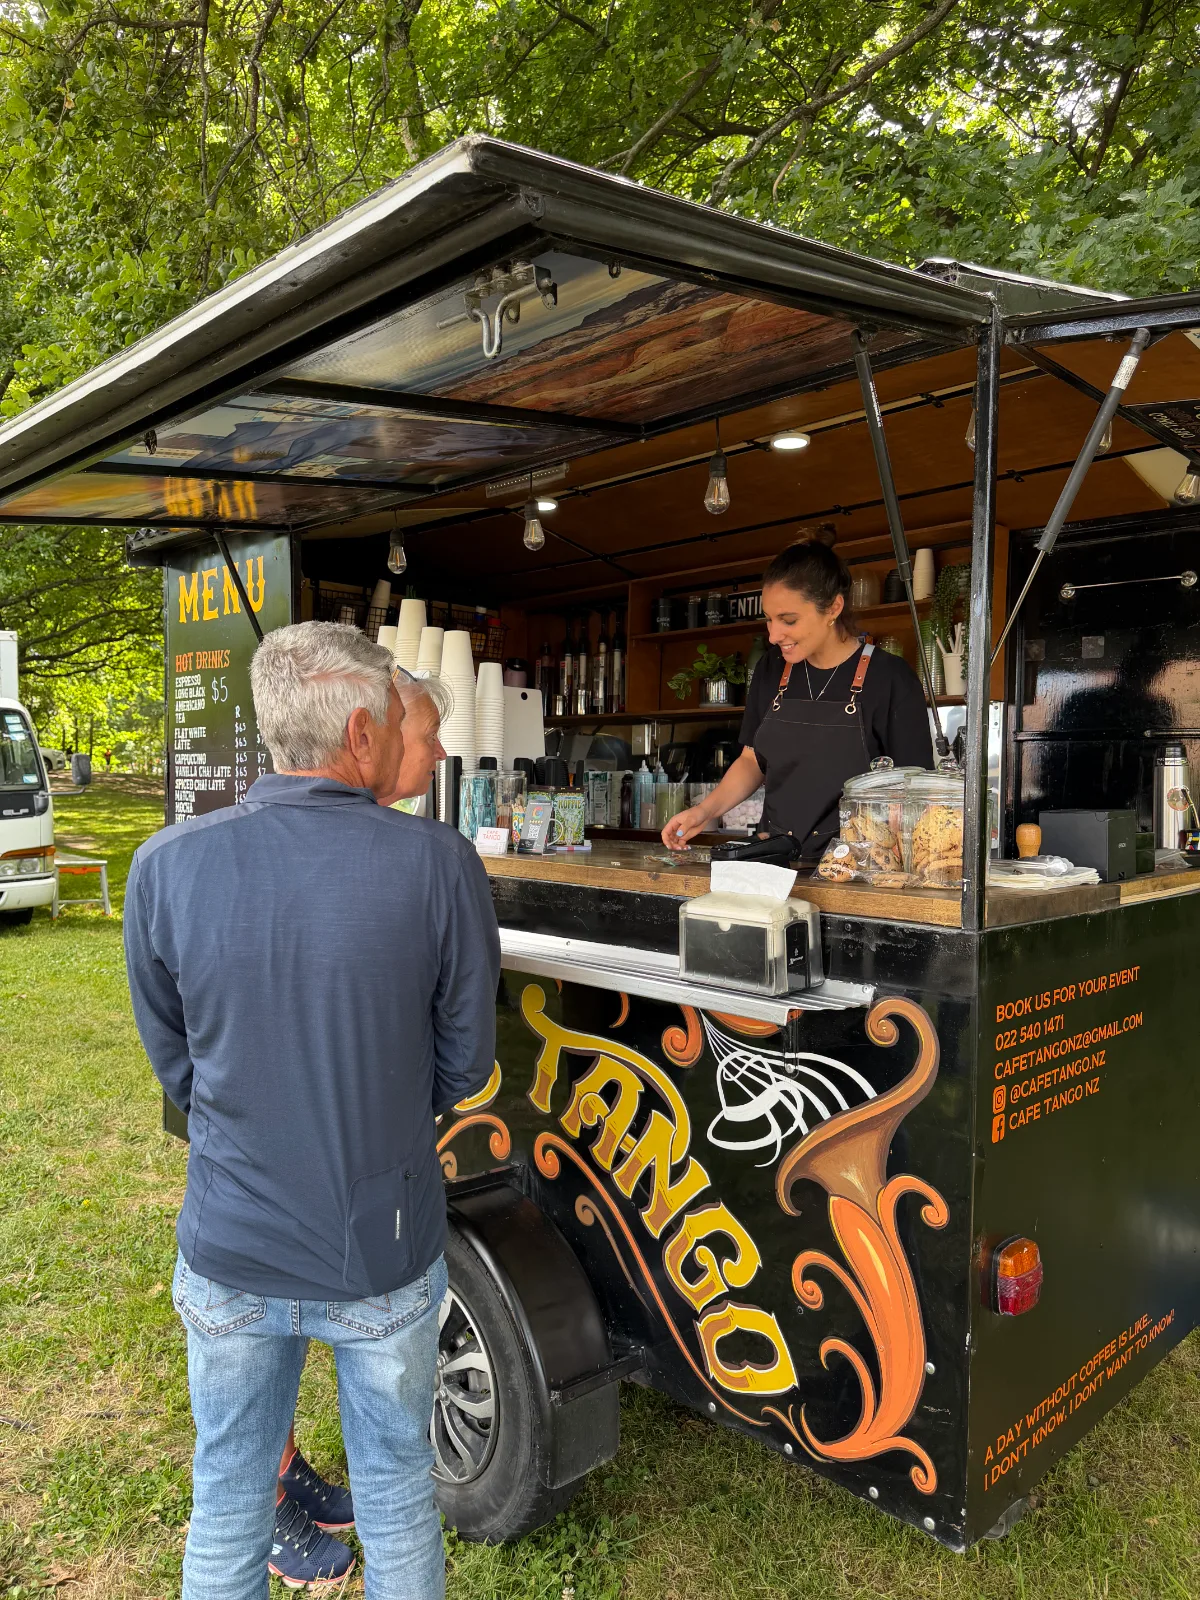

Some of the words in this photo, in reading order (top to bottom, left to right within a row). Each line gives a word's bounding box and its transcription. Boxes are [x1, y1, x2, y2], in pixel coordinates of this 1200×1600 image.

[178, 555, 266, 624] MENU
[175, 651, 194, 673] HOT
[195, 649, 231, 670] DRINKS
[174, 688, 189, 700] LONG
[188, 686, 206, 699] BLACK
[175, 673, 202, 688] ESPRESSO
[211, 676, 229, 705] $5
[175, 698, 206, 712] AMERICANO
[235, 704, 241, 719] R
[175, 711, 186, 724] TEA
[174, 727, 188, 740] FLAT
[188, 726, 207, 739] WHITE
[174, 739, 191, 751] LATTE
[174, 752, 207, 766] CAPPUCCINO
[174, 765, 198, 778] VANILLA
[198, 765, 212, 778] CHAI
[213, 766, 232, 778] LATTE
[174, 778, 194, 791] SPICED
[194, 778, 208, 792] CHAI
[208, 778, 226, 791] LATTE
[174, 789, 196, 803] MATCHA
[174, 801, 194, 814] MOCHA
[996, 996, 1033, 1023] BOOK
[1034, 991, 1051, 1011] US
[1052, 984, 1076, 1006] FOR
[1078, 975, 1107, 998] YOUR
[1108, 965, 1141, 989] EVENT
[995, 1029, 1017, 1051] 022
[1019, 1021, 1041, 1043] 540
[1043, 1013, 1065, 1036] 1471
[994, 1011, 1143, 1080] CAFETANGONZ@GMAIL.COM
[1010, 1050, 1106, 1104] @CAFETANGO.NZ
[1008, 1102, 1041, 1130] CAFE
[1043, 1084, 1083, 1115] TANGO
[1085, 1076, 1101, 1097] NZ
[521, 982, 800, 1398] TANGO
[984, 1445, 994, 1466] A
[996, 1419, 1023, 1455] DAY
[1025, 1372, 1078, 1429] WITHOUT
[1079, 1341, 1117, 1383] COFFEE
[1118, 1331, 1128, 1350] IS
[984, 1473, 989, 1492] I
[991, 1439, 1030, 1485] DON'T
[1074, 1370, 1105, 1410] DON'T
[1106, 1347, 1133, 1380] WANT
[1135, 1335, 1148, 1354] TO
[1149, 1308, 1175, 1344] KNOW!
